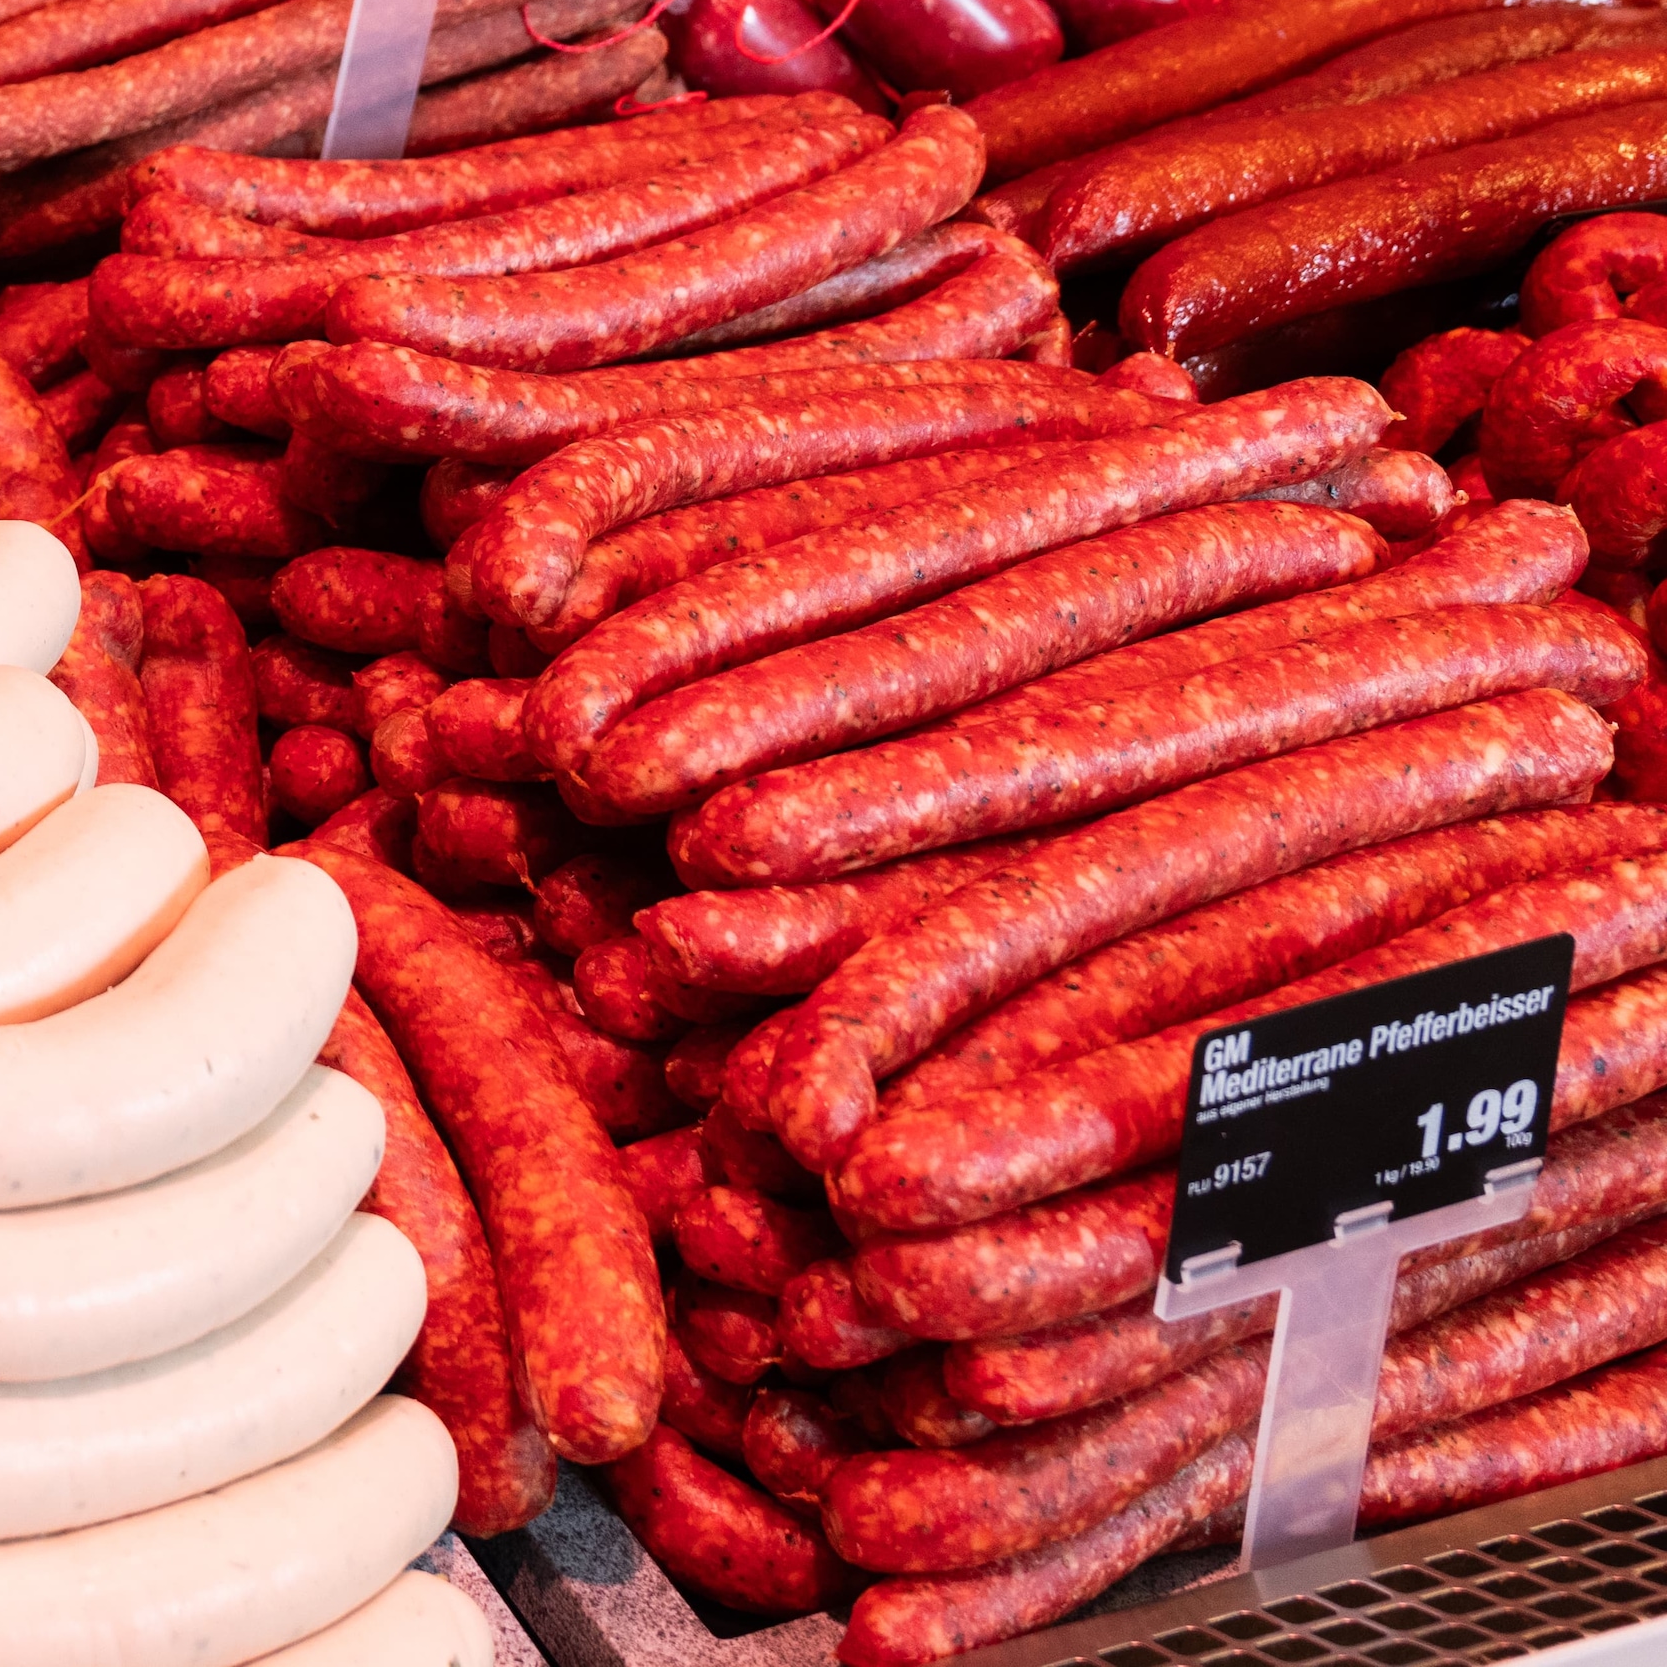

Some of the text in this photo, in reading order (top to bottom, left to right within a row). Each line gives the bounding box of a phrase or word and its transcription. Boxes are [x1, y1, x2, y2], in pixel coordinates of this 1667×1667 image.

[1200, 985, 1555, 1106] Mediterrane Pfefferbeisser
[1204, 1030, 1252, 1072] GM
[1196, 1108, 1218, 1125] aus
[1417, 1078, 1538, 1159] 1.99
[1187, 1150, 1273, 1198] PLU 9157
